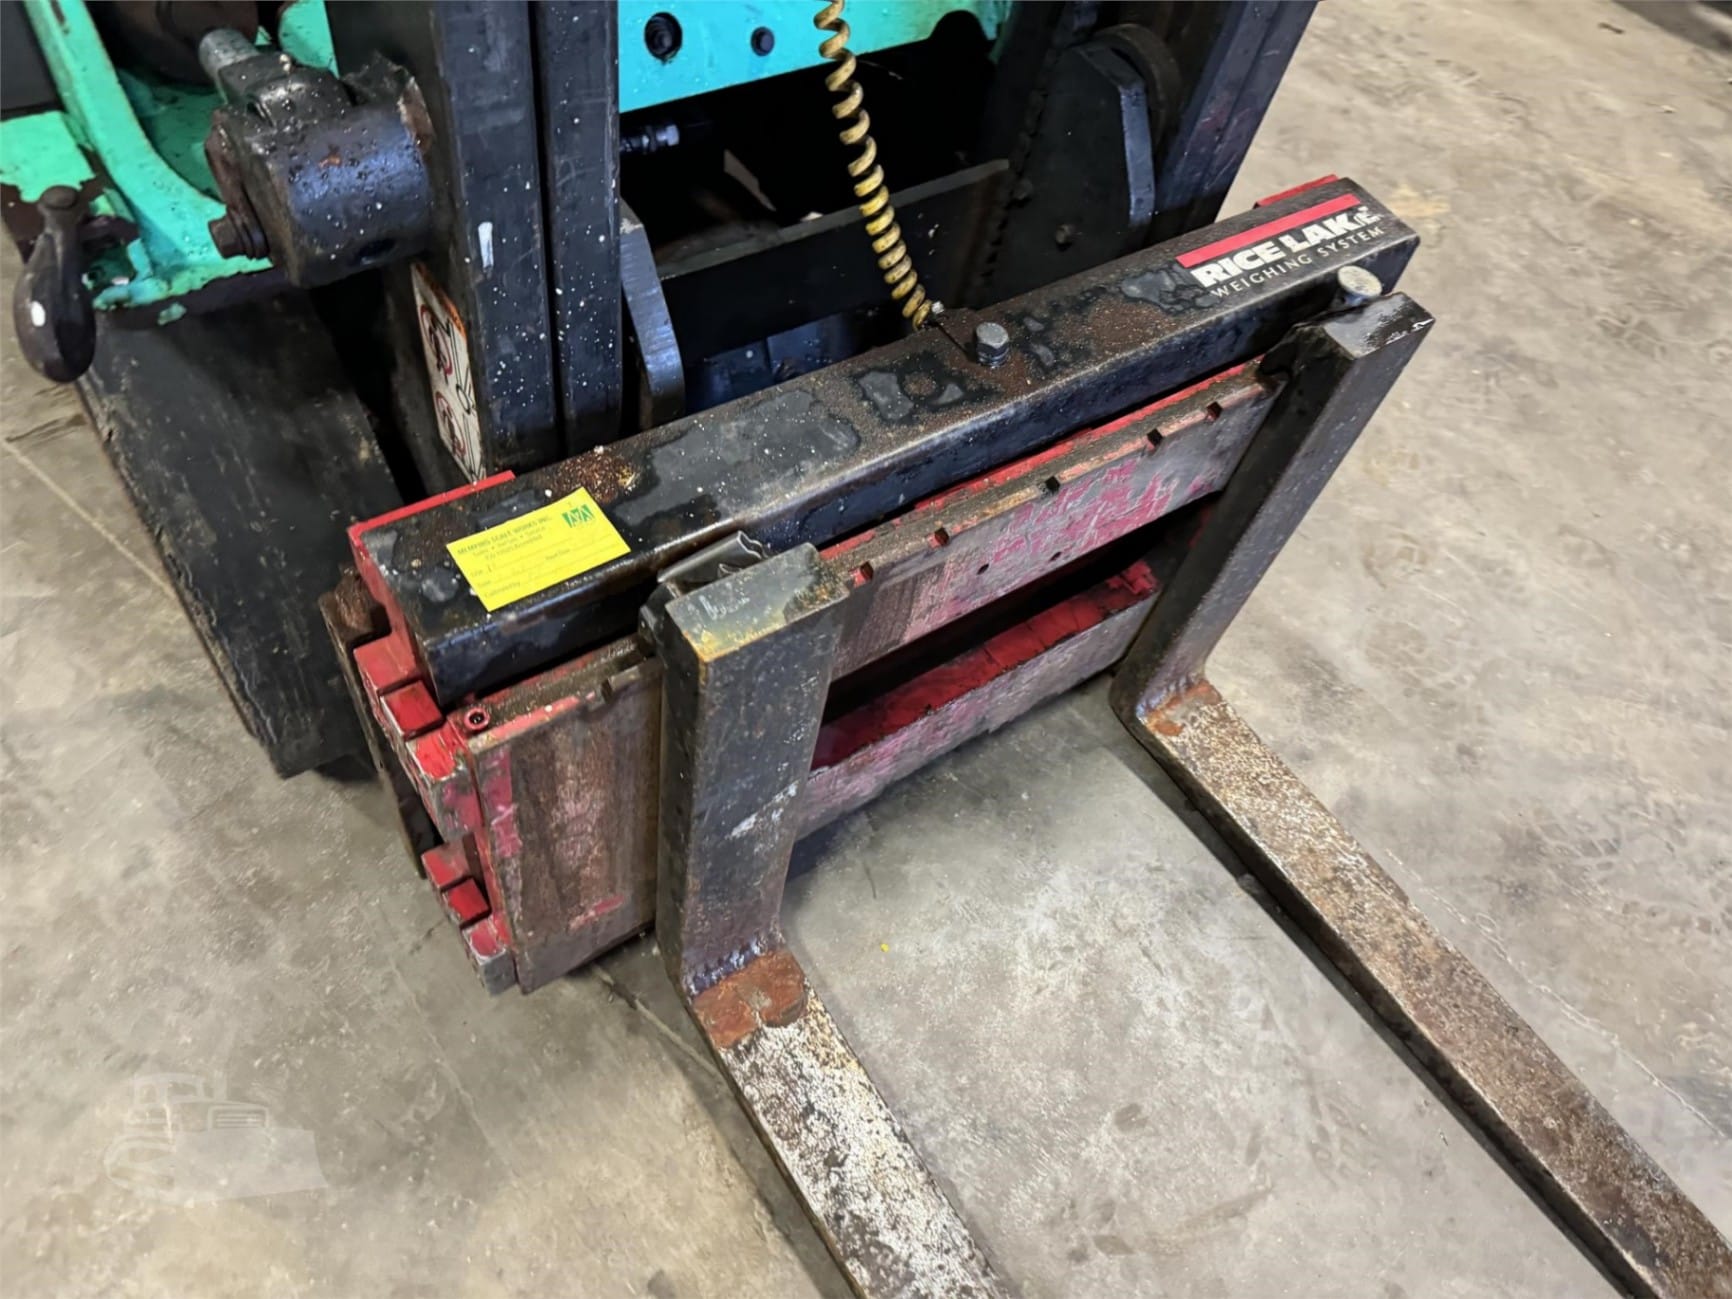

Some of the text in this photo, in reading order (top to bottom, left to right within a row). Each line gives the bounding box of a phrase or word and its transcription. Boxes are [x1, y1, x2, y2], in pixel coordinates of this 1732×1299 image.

[1189, 205, 1382, 288] RICE LAKE
[1210, 226, 1385, 298] WEIGHING SYSTEM
